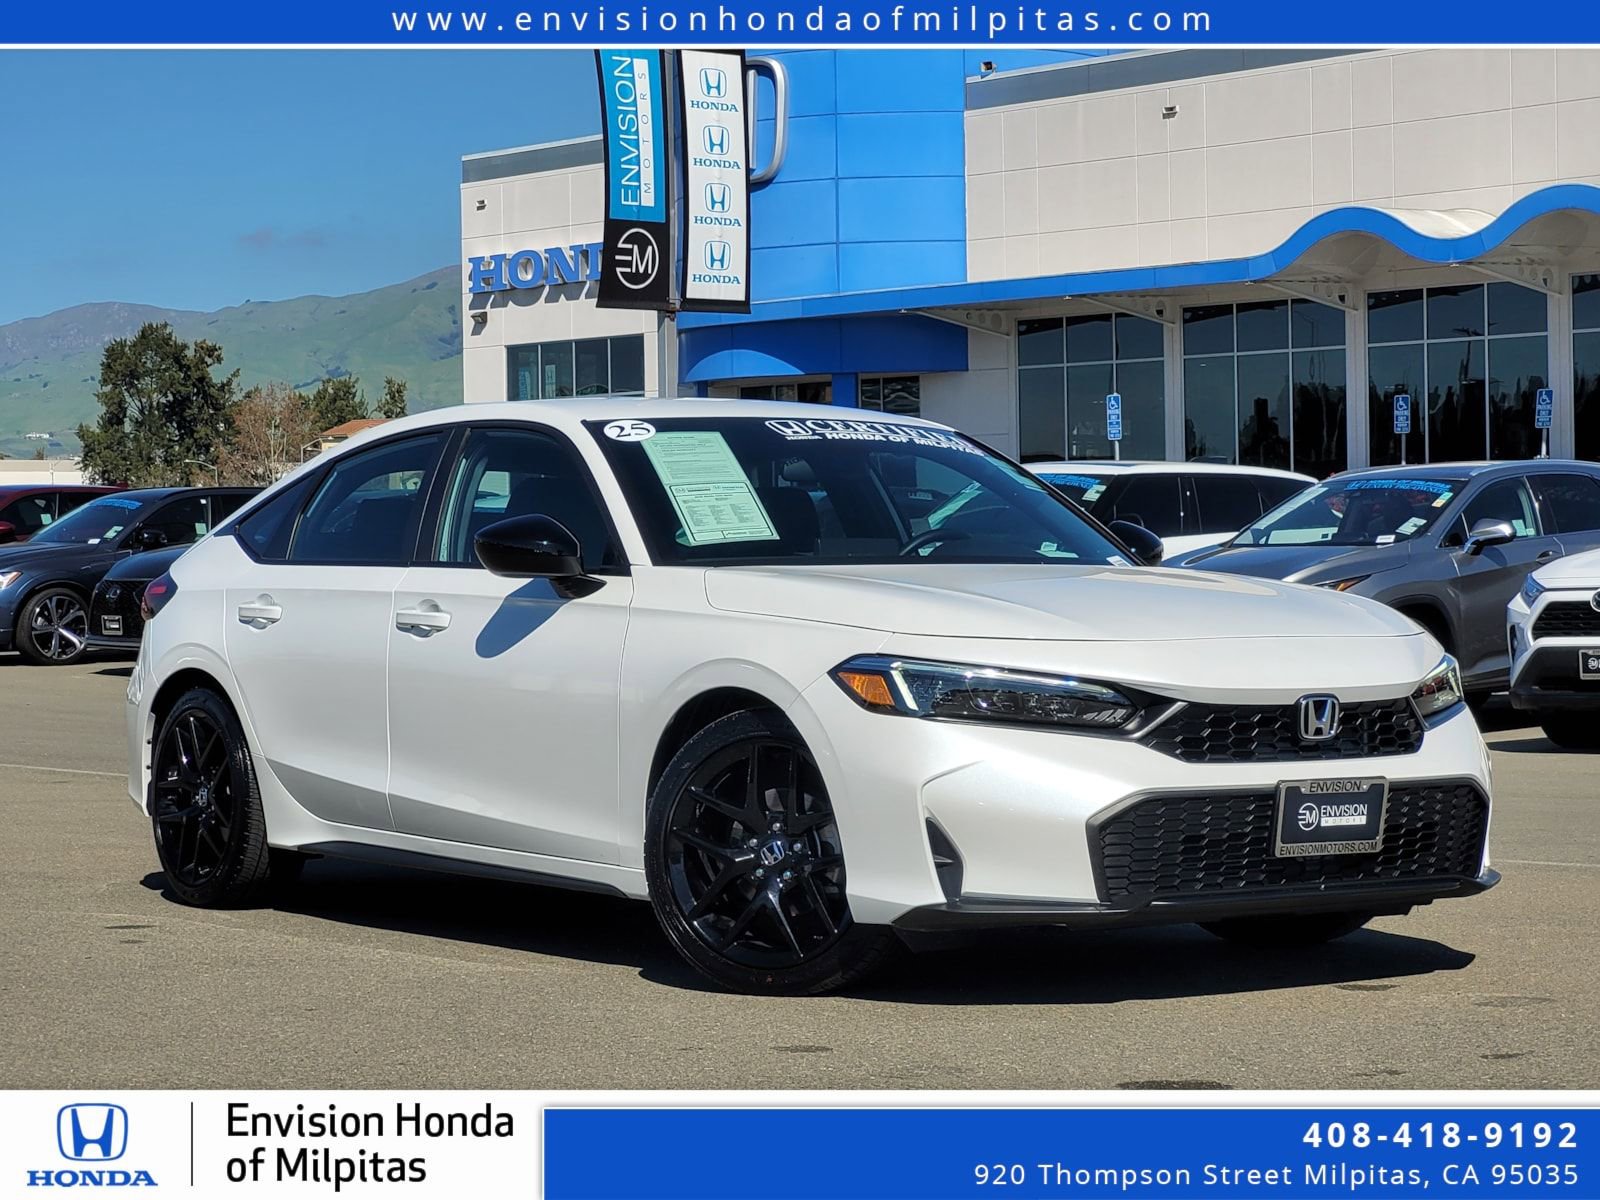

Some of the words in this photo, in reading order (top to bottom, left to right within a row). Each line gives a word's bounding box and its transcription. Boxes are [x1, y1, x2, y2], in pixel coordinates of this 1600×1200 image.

[690, 100, 739, 113] HONDA
[612, 55, 640, 207] ENVISION
[638, 72, 652, 194] MOTORS
[692, 157, 741, 170] HONDA
[694, 215, 742, 227] HONDA
[691, 273, 741, 285] HONDA
[609, 423, 651, 438] 25
[825, 432, 887, 442] HONDA
[888, 434, 911, 444] OF
[1309, 780, 1362, 793] ENVISION
[1320, 803, 1368, 817] ENVISION
[1280, 841, 1378, 856] ENVISIONMOTORS.COM
